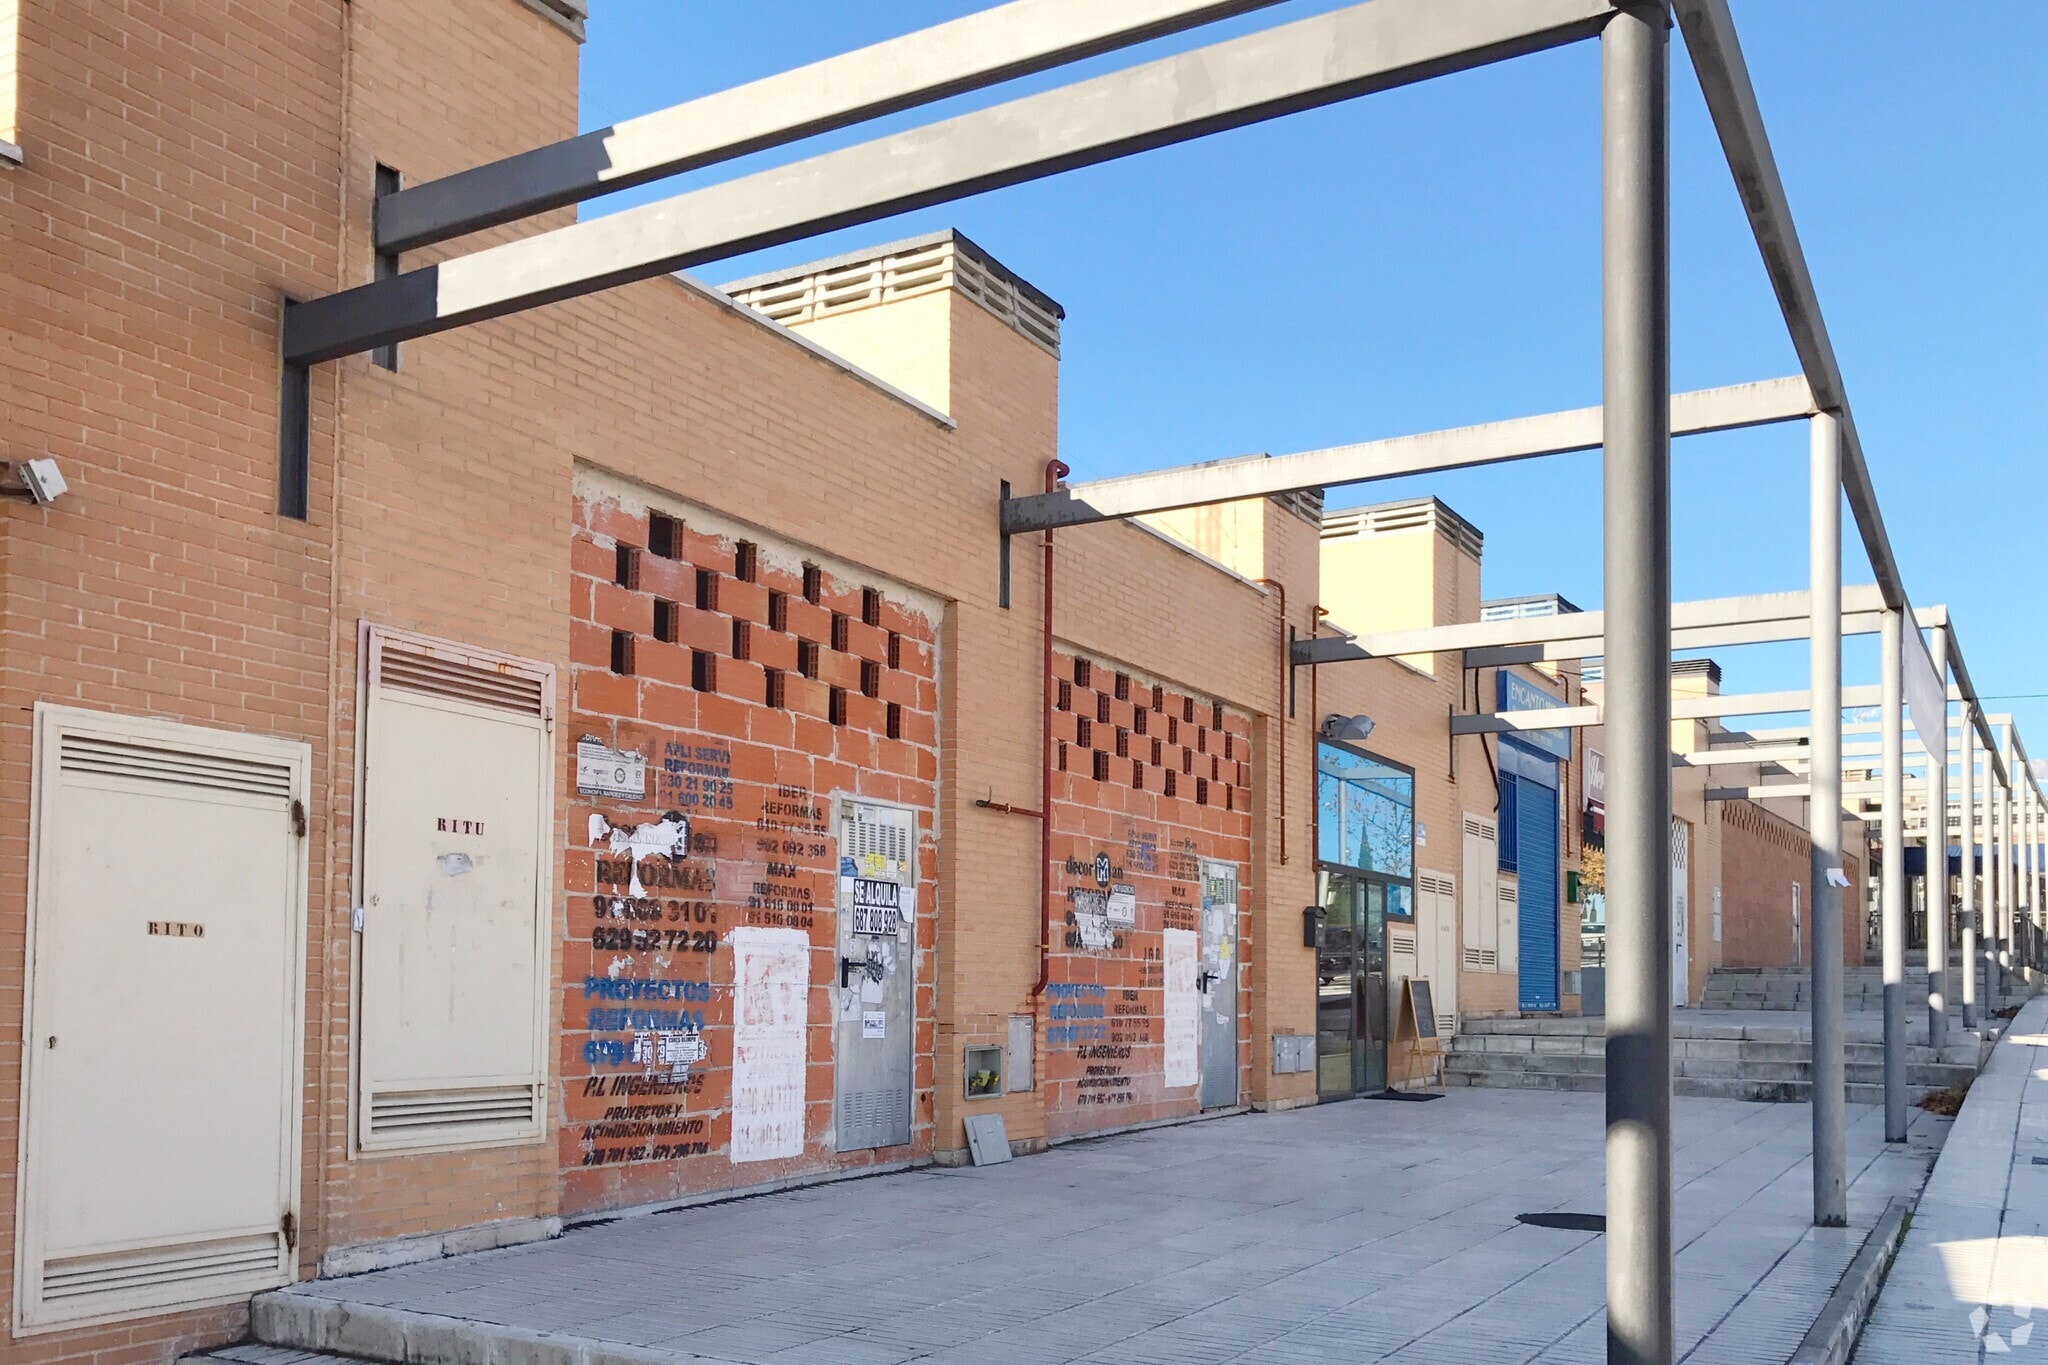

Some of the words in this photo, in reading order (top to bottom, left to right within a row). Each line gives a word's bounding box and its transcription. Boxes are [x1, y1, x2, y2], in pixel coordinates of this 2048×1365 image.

[1511, 682, 1544, 710] ENCANTO
[664, 742, 691, 758] APLI
[696, 747, 730, 764] SERVI
[664, 757, 729, 778] REFORMAS
[685, 776, 698, 790] 21
[702, 779, 716, 793] 90
[719, 781, 733, 795] 25
[778, 784, 808, 800] IBER
[702, 793, 716, 809] 20
[762, 801, 822, 820] REFORMAS
[437, 817, 485, 836] RITU
[807, 843, 826, 857] 368
[766, 861, 796, 878] MAX
[753, 882, 810, 900] REFORMAS
[854, 880, 865, 904] SE
[866, 881, 898, 907] ALQUILA
[1172, 886, 1186, 897] MAX
[148, 921, 203, 937] RITO
[800, 916, 814, 928] 04
[855, 907, 868, 931] 687
[870, 908, 882, 932] 808
[884, 910, 897, 933] 928
[664, 929, 690, 952] 72
[692, 930, 718, 954] 20
[584, 976, 710, 1002] PROYECTOS
[1122, 989, 1139, 1001] IBER
[604, 1104, 672, 1120] PROYECTOS
[674, 1104, 684, 1118] Y
[582, 1120, 703, 1141] ACONDICIONAMIENTO
